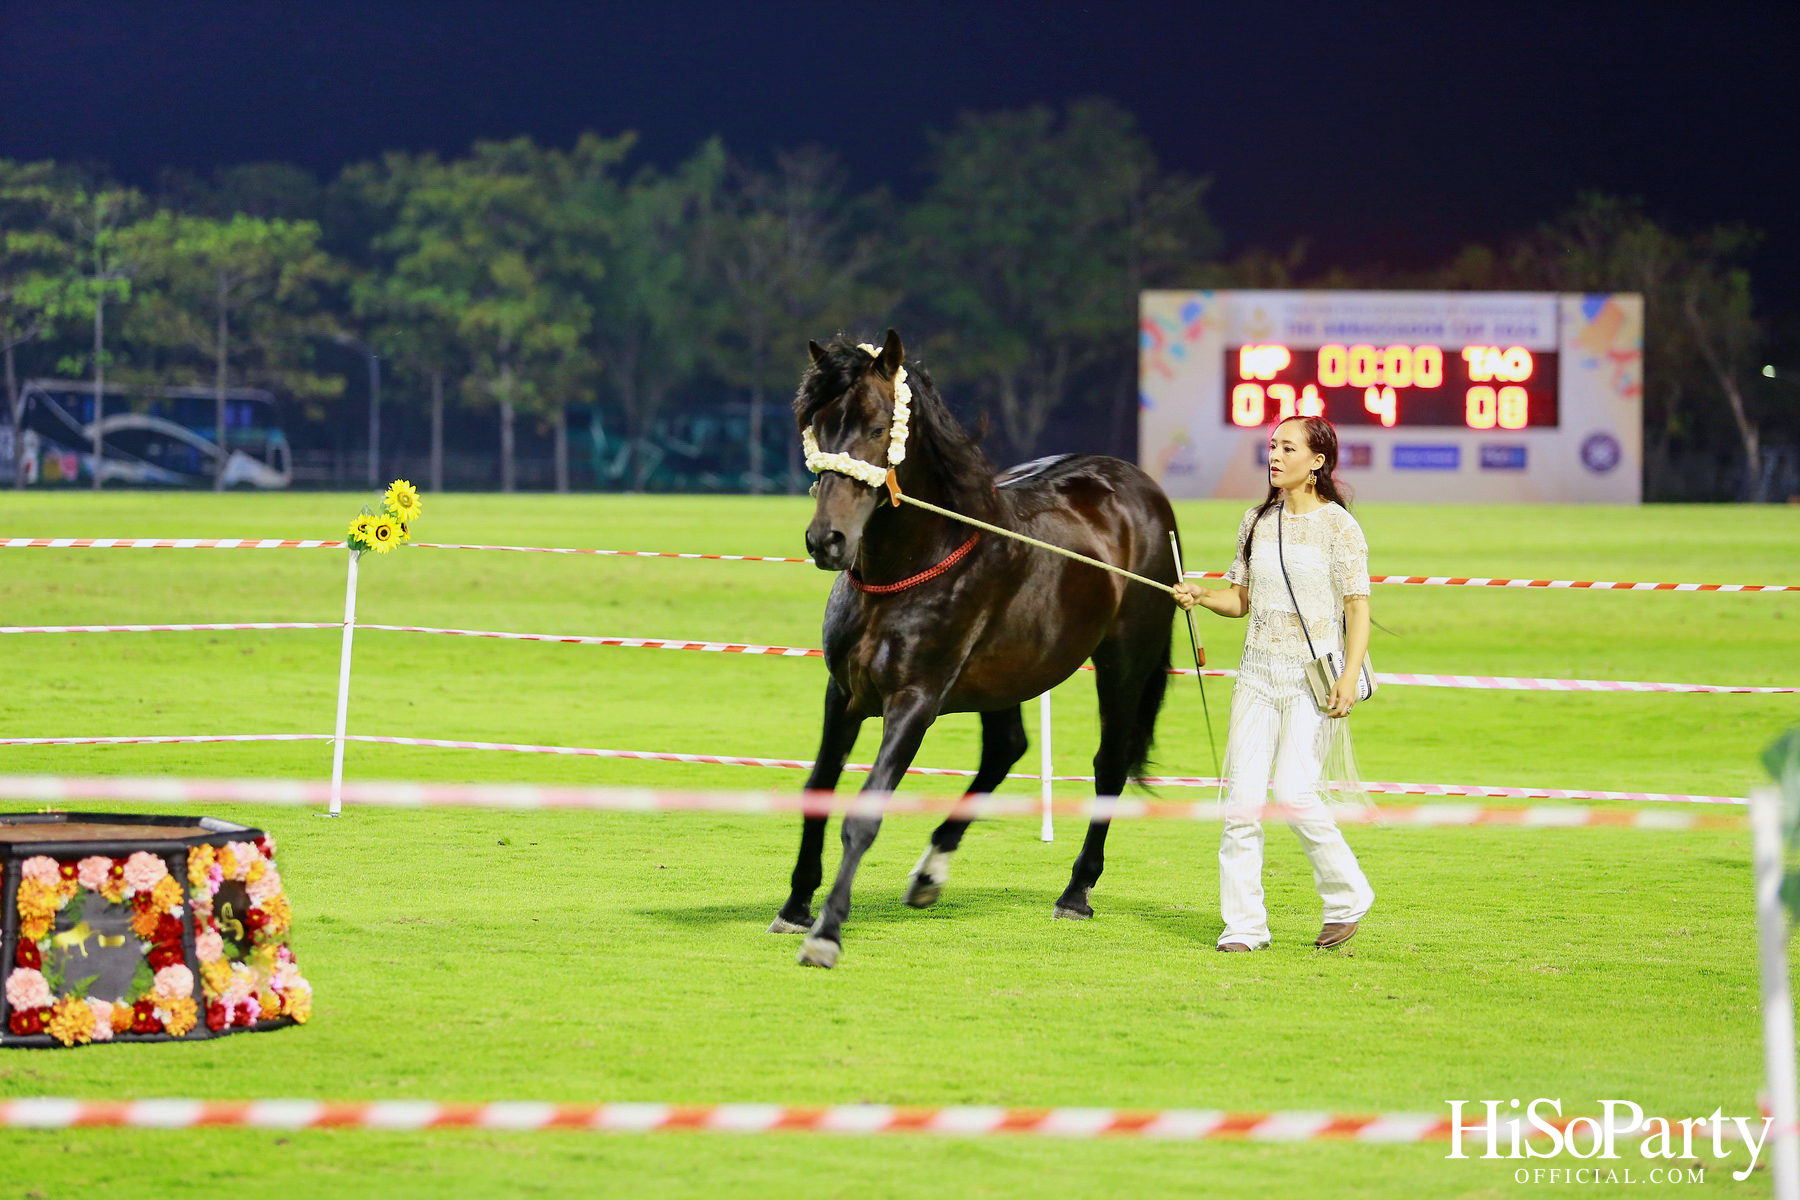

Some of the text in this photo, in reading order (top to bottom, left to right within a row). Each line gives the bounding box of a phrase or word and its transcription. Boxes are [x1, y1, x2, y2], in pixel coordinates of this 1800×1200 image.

[1318, 344, 1443, 388] 00:00
[1462, 345, 1533, 382] TAO
[1365, 386, 1396, 427] 4
